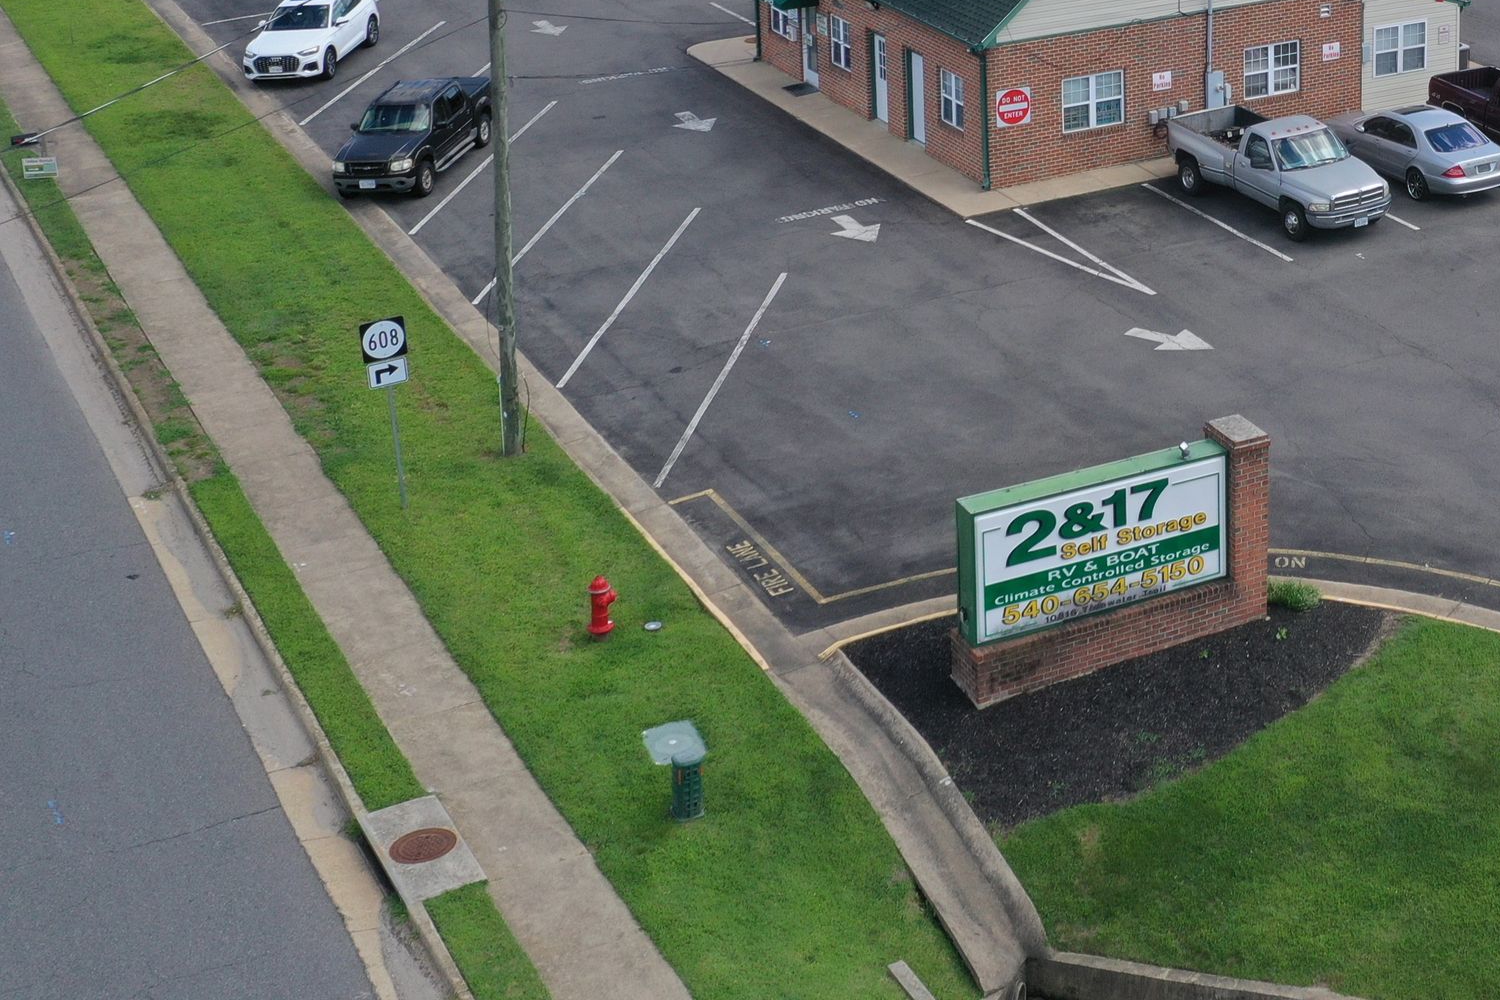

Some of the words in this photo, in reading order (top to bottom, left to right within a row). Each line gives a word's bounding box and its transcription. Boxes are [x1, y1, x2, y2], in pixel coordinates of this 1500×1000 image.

[1004, 111, 1024, 119] ENTER
[1013, 94, 1025, 102] NOT
[368, 328, 399, 351] 608
[1005, 477, 1169, 568] 2&17
[1060, 534, 1108, 560] Self
[1117, 511, 1207, 546] Storage
[725, 540, 769, 570] LANE
[1047, 564, 1078, 582] RV
[1083, 560, 1098, 572] &
[1106, 543, 1160, 567] BOAT
[753, 567, 795, 597] FIRE
[994, 583, 1056, 606] Climate
[1061, 559, 1144, 589] Controlled
[1150, 542, 1210, 566] Storage
[1001, 554, 1205, 625] 540-654-5150
